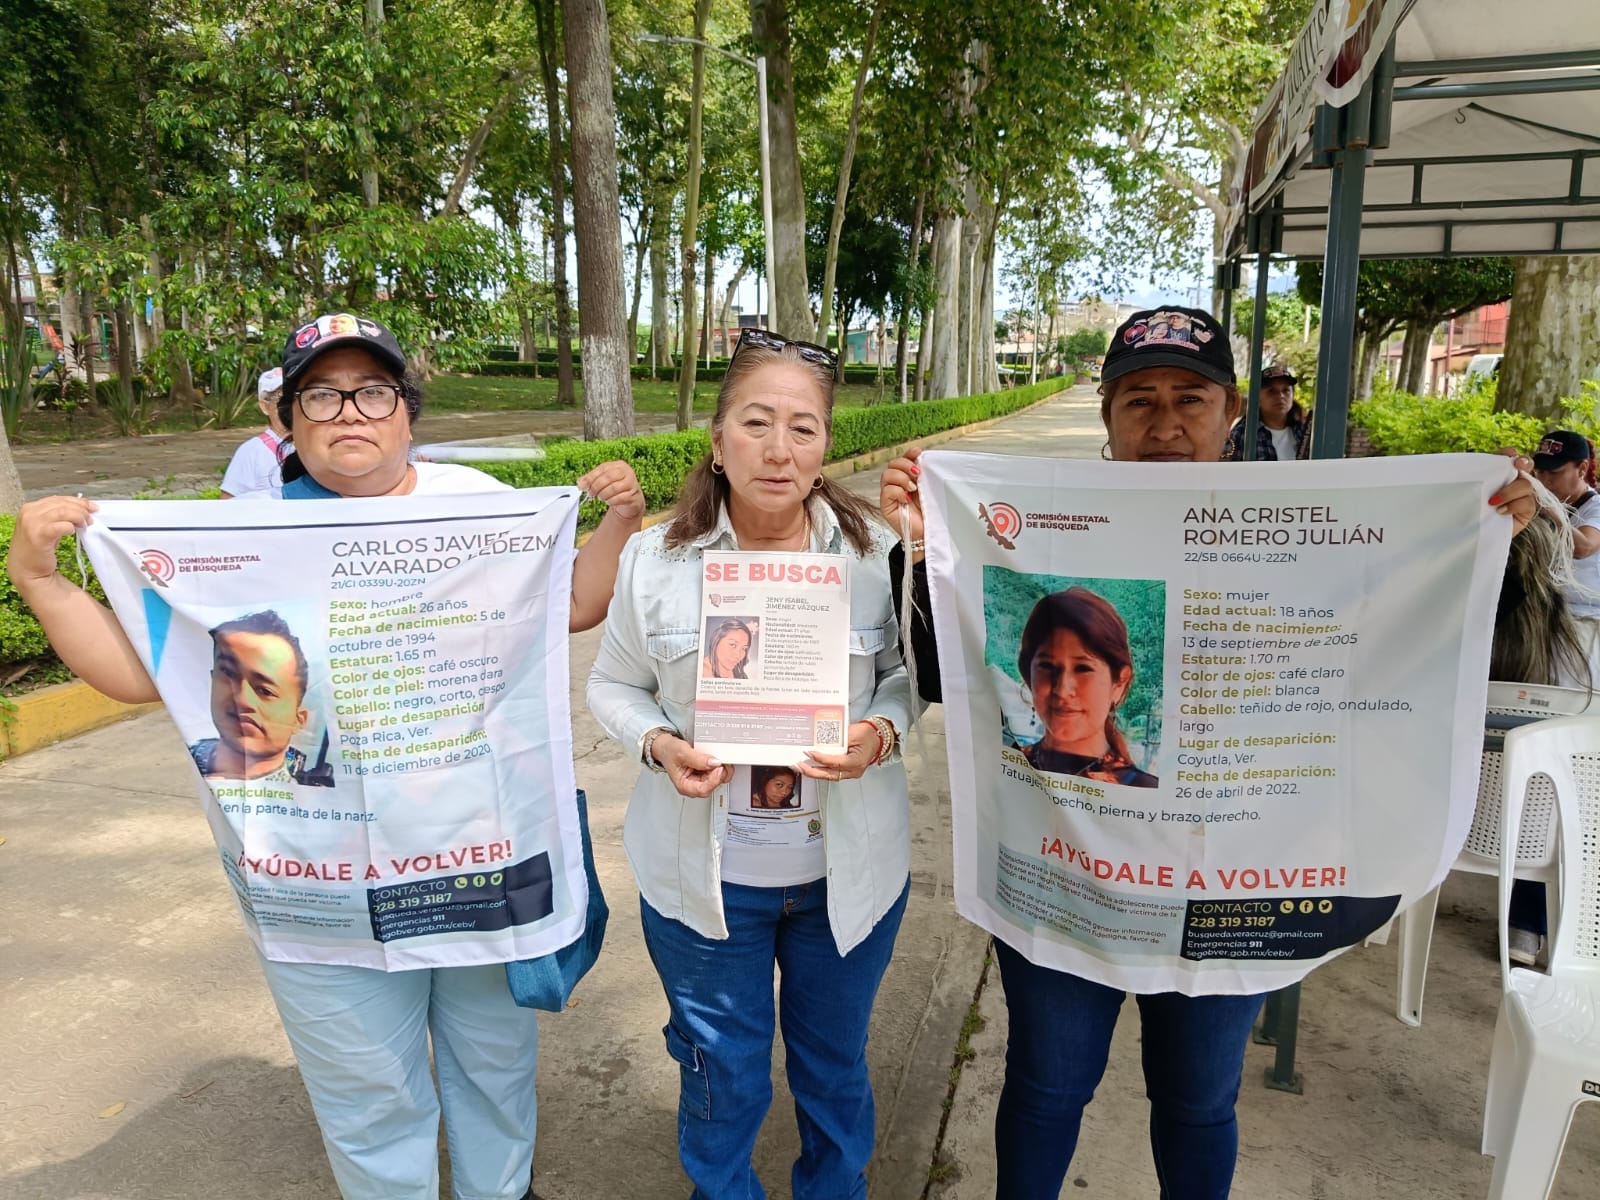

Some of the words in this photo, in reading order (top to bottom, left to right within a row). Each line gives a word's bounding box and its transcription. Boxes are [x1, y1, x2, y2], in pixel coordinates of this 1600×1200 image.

[1026, 513, 1070, 522] COMISIÓN
[1072, 515, 1110, 523] ESTATAL
[1183, 507, 1235, 524] ANA
[1241, 506, 1338, 524] CRISTEL
[1040, 521, 1089, 531] BÚSQUEDA
[1184, 528, 1290, 546] ROMERO
[1296, 523, 1384, 546] JULIÁN
[332, 538, 428, 557] CARLOS
[178, 556, 222, 565] COMISIÓN
[223, 555, 262, 564] ESTATAL
[1184, 552, 1218, 562] 22/SB
[1221, 552, 1297, 563] 0664U-22ZN
[179, 565, 192, 573] DE
[193, 563, 242, 573] BÚSQUEDA
[331, 556, 461, 577] ALVARADO
[705, 563, 739, 582] SE
[749, 563, 842, 585] BUSCA
[1183, 589, 1221, 600] Sexo:
[1226, 590, 1270, 602] mujer
[329, 613, 365, 623] Edad
[369, 604, 417, 620] actual:
[419, 602, 434, 614] 26
[437, 600, 468, 611] años
[330, 600, 367, 609] Sexo:
[1183, 605, 1220, 616] Edad
[1225, 605, 1276, 616] actual:
[1279, 606, 1295, 617] 18
[1298, 607, 1334, 618] años
[329, 625, 372, 637] Fecha
[375, 622, 393, 633] de
[397, 613, 477, 631] nacimiento:
[480, 611, 488, 621] 5
[491, 609, 506, 620] de
[1183, 620, 1228, 632] Fecha
[1232, 620, 1251, 632] de
[1255, 622, 1342, 635] nacimiento:
[329, 639, 382, 653] octubre
[386, 636, 403, 647] de
[406, 632, 436, 645] 1994
[1182, 637, 1195, 648] 13
[1198, 637, 1218, 649] de
[1220, 638, 1301, 651] septiembre
[1304, 638, 1321, 648] de
[1323, 633, 1358, 647] 2005
[330, 654, 393, 669] Estatura:
[396, 649, 420, 662] 1.65
[423, 649, 437, 658] m
[1181, 653, 1247, 665] Estatura:
[1250, 653, 1274, 665] 1.70
[1277, 654, 1290, 664] m
[332, 672, 368, 684] Color
[372, 669, 389, 680] de
[394, 666, 425, 679] ojos:
[429, 659, 456, 673] café
[459, 655, 498, 669] oscuro
[1180, 670, 1219, 682] Color
[1222, 670, 1240, 681] de
[1244, 669, 1276, 683] ojos:
[1279, 667, 1308, 681] café
[1311, 667, 1345, 679] claro
[333, 688, 369, 700] Color
[373, 685, 391, 696] de
[395, 680, 424, 695] piel:
[428, 674, 478, 688] morena
[1180, 686, 1218, 699] Color
[1221, 686, 1239, 698] de
[1242, 685, 1272, 700] piel:
[1275, 684, 1321, 697] blanca
[336, 701, 391, 715] Cabello:
[394, 696, 436, 709] negro,
[439, 689, 476, 703] corto,
[1180, 703, 1237, 715] Cabello:
[1239, 702, 1282, 714] teñido
[1285, 701, 1302, 712] de
[1305, 701, 1335, 714] rojo,
[1338, 699, 1413, 713] ondulado,
[338, 719, 376, 732] Lugar
[380, 715, 397, 726] de
[1179, 720, 1215, 735] largo
[340, 734, 368, 746] Poza
[373, 731, 405, 743] Rica,
[408, 726, 433, 738] Ver.
[1178, 737, 1220, 751] Lugar
[1223, 736, 1240, 748] de
[1243, 733, 1337, 750] desaparición:
[342, 748, 379, 761] Fecha
[384, 745, 401, 757] de
[343, 764, 352, 775] 11
[355, 764, 369, 775] de
[372, 756, 441, 774] diciembre
[444, 752, 461, 764] de
[464, 743, 493, 760] 2020.
[1177, 753, 1231, 768] Coyutla,
[1234, 753, 1257, 764] Ver.
[1177, 770, 1219, 782] Fecha
[1223, 769, 1239, 781] de
[1242, 766, 1337, 783] desaparición:
[217, 786, 294, 800] particulares:
[1175, 787, 1192, 799] 26
[1195, 787, 1213, 799] de
[1216, 786, 1243, 798] abril
[1246, 785, 1263, 796] de
[1265, 783, 1301, 795] 2022.
[224, 804, 239, 813] en
[241, 803, 251, 814] la
[255, 804, 287, 815] parte
[290, 808, 309, 818] alta
[312, 808, 328, 819] de
[331, 810, 341, 821] la
[344, 811, 378, 822] nariz.
[1099, 804, 1145, 820] pierna
[1147, 811, 1158, 823] y
[1161, 810, 1202, 824] brazo
[1205, 809, 1261, 824] derecho.
[364, 863, 381, 880] A
[391, 839, 513, 875] VOLVER!
[1040, 836, 1174, 888] ¡AYÚDALE
[1185, 869, 1207, 890] A
[1217, 866, 1347, 890] VOLVER!
[372, 881, 447, 902] CONTACTO
[398, 897, 420, 909] 319
[423, 893, 453, 905] 3187
[1192, 902, 1272, 914] CONTACTO
[1189, 917, 1216, 928] 228
[1218, 917, 1242, 927] 319
[1244, 916, 1276, 927] 3187
[1188, 929, 1323, 939] busqueda.veracruz@gmail.com
[1187, 940, 1248, 949] Emergencias
[1249, 940, 1263, 948] 911
